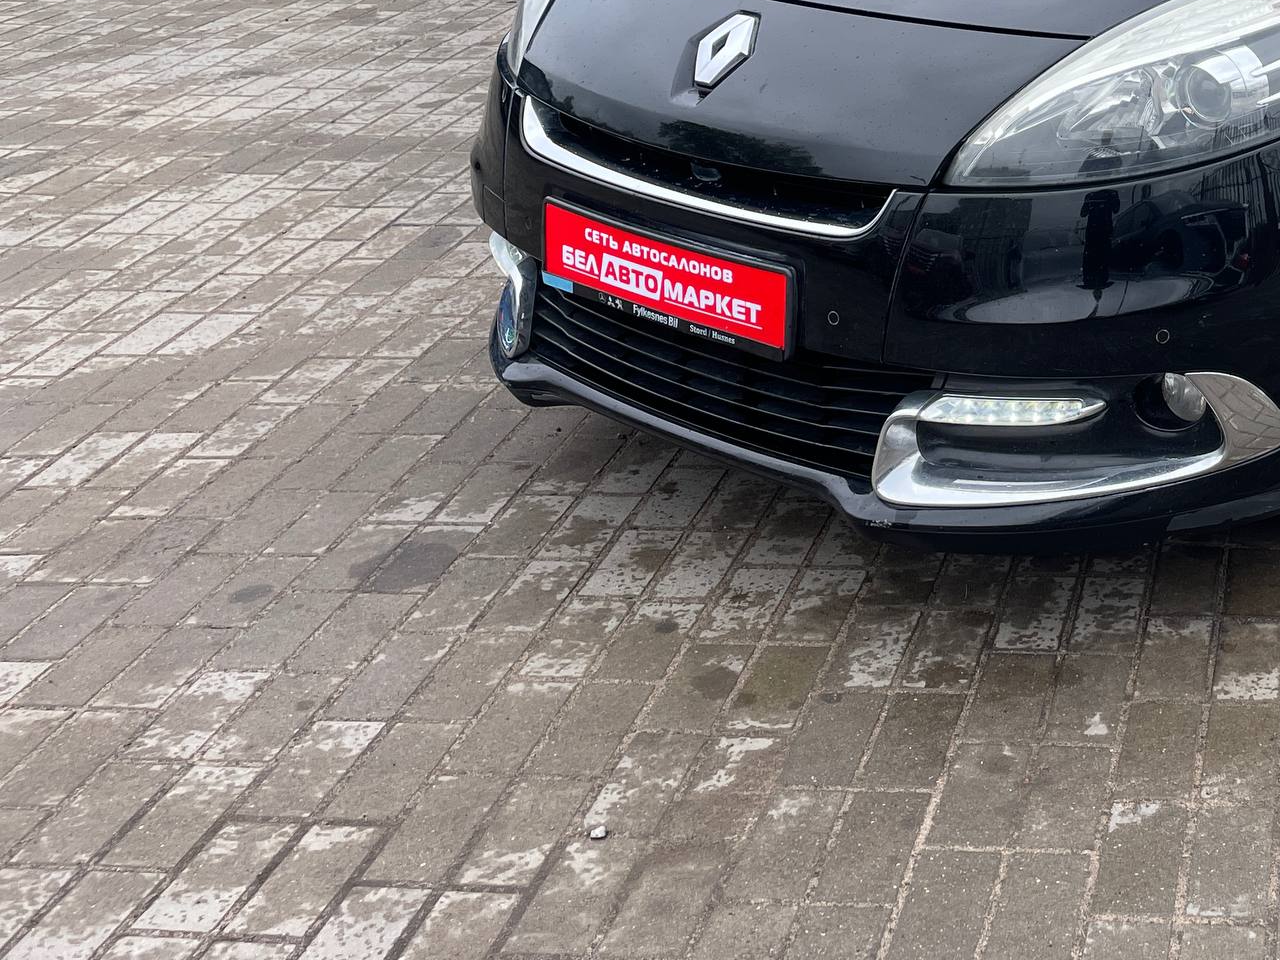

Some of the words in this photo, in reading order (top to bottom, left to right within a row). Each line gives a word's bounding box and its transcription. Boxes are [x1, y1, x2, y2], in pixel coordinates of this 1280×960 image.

[584, 227, 619, 250] СЕТЬ
[622, 240, 733, 284] АВТОСАЛОНОВ
[632, 304, 668, 325] Fylkesnes
[689, 324, 708, 337] Stord
[712, 330, 736, 345] Husnes
